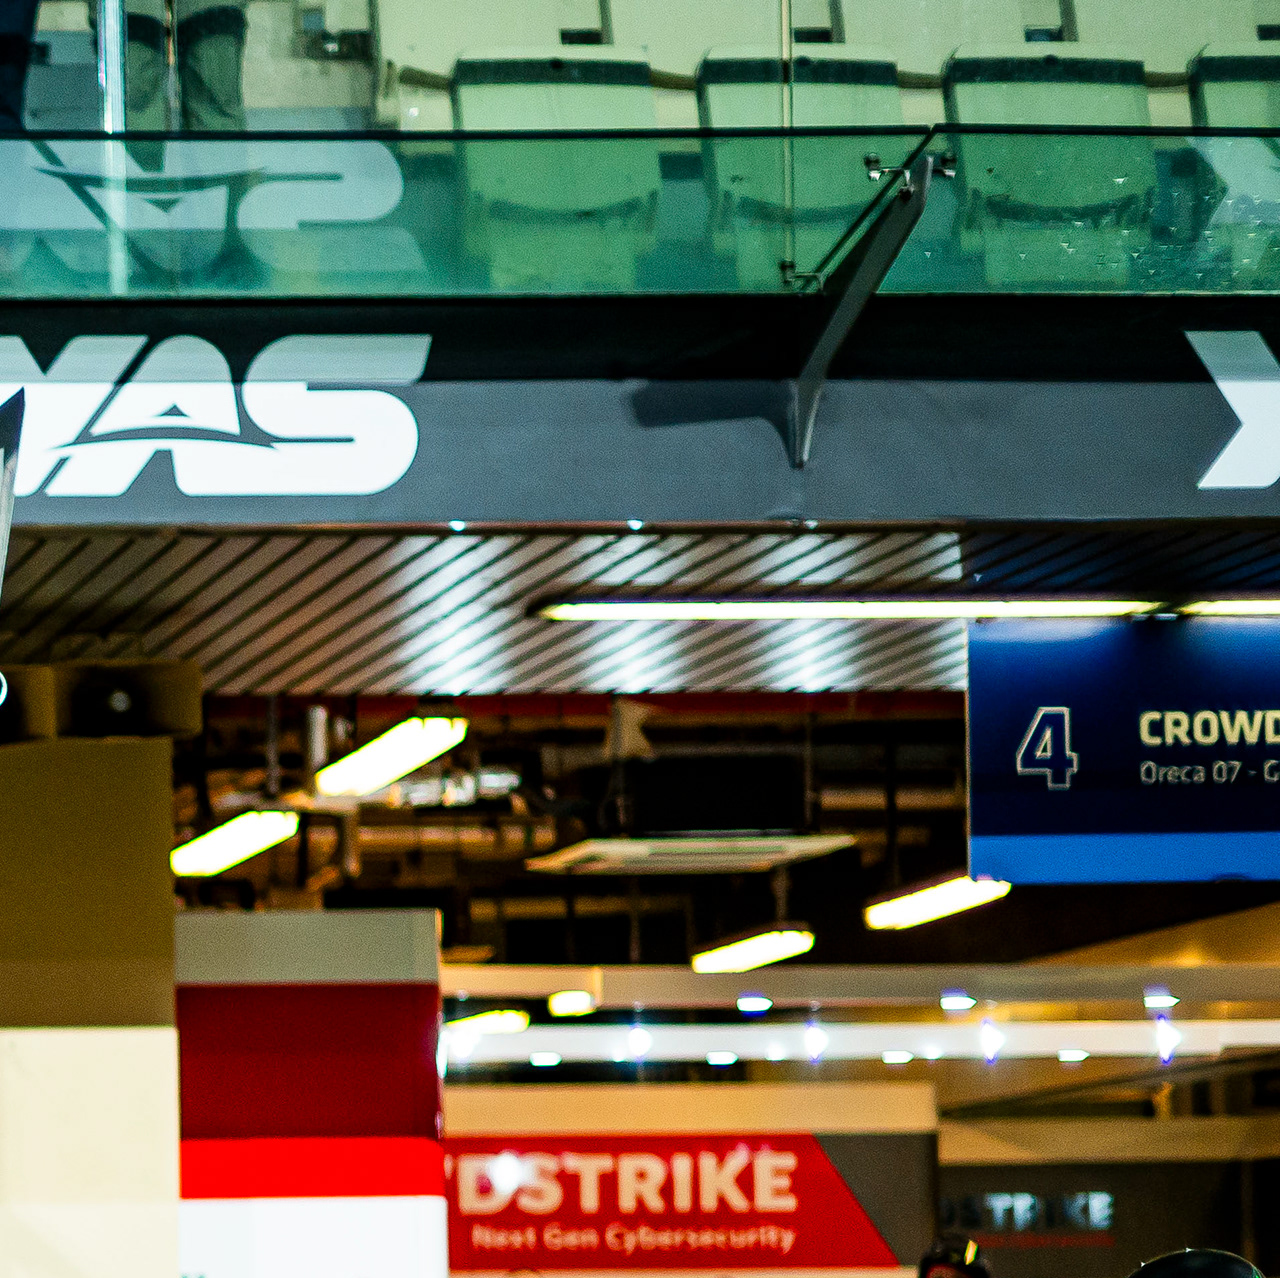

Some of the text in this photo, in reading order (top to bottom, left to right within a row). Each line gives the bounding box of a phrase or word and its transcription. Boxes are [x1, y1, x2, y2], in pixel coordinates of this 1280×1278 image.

[1016, 706, 1080, 791] 4
[1140, 760, 1206, 784] Oreca
[1212, 760, 1242, 784] 07
[446, 1149, 798, 1215] DSTRIKE
[471, 1222, 797, 1257] Next Gen Cybersecurity
